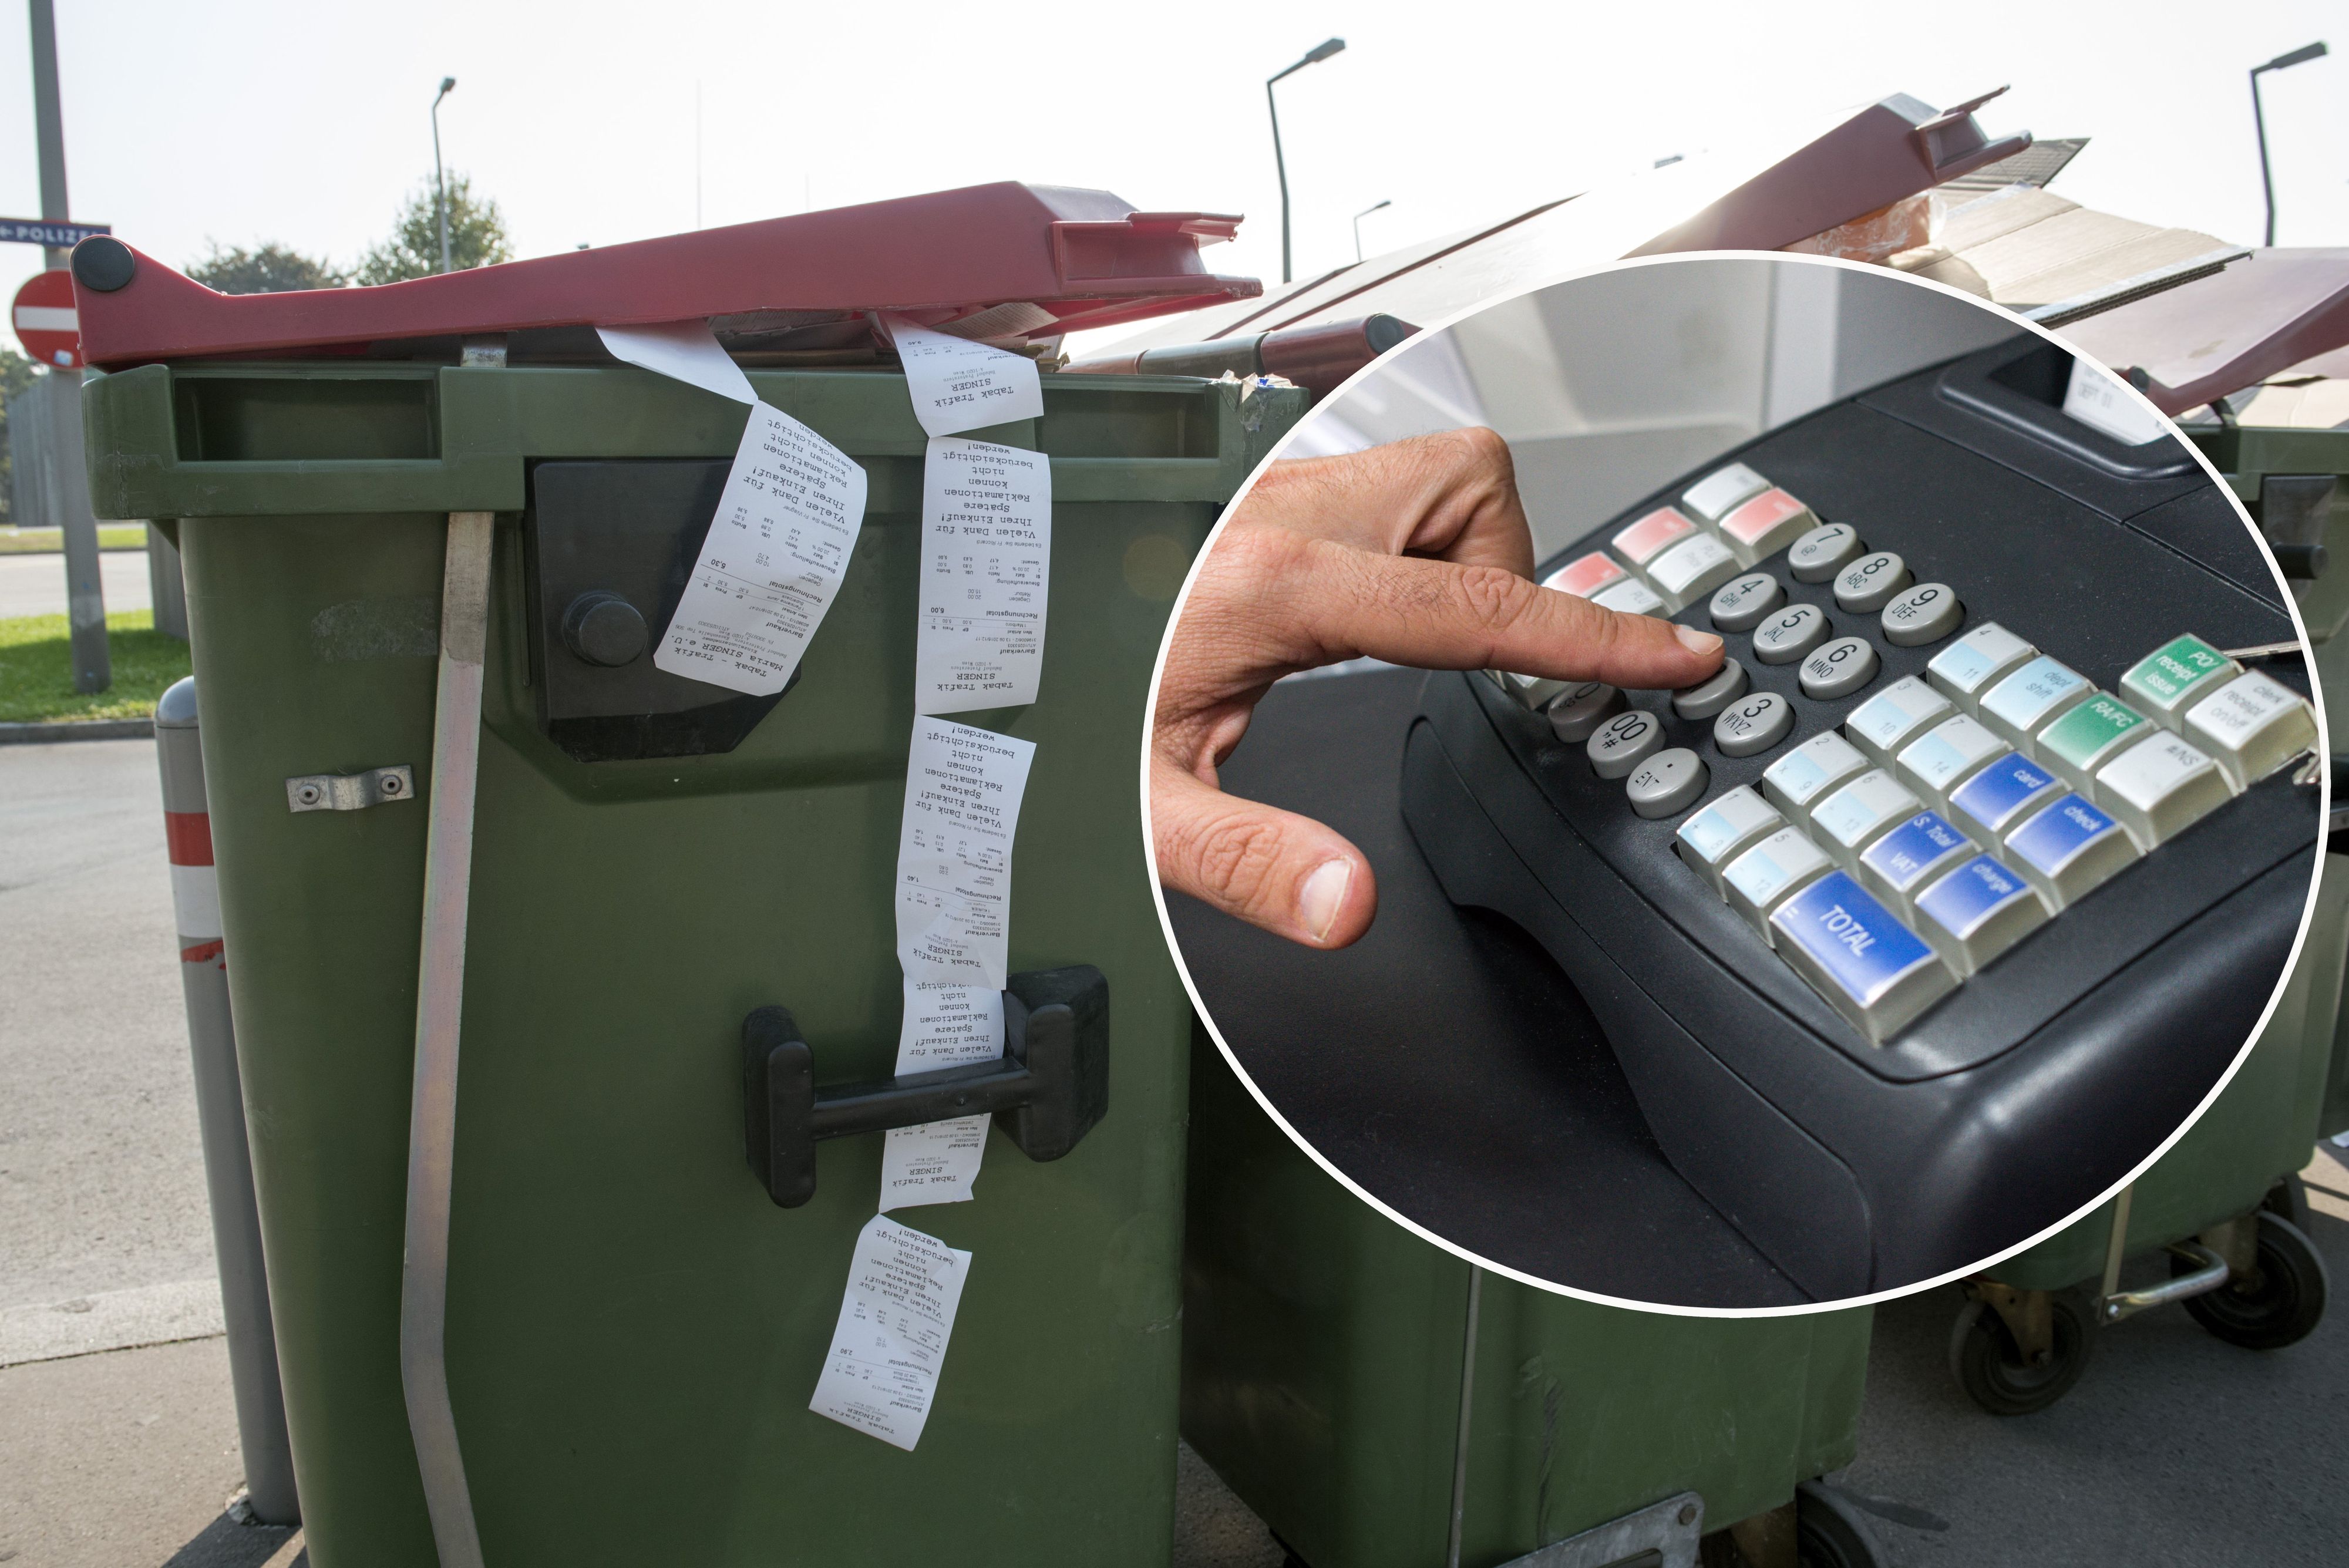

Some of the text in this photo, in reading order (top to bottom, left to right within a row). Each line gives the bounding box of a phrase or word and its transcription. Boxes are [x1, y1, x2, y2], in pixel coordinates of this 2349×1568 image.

[951, 378, 991, 391] SINGER
[934, 386, 1014, 407] Tabak Trafik
[767, 419, 852, 472] berücksichtigt
[968, 443, 1009, 454] werden!
[770, 433, 846, 477] können nicht
[943, 451, 1033, 469] berücksichtigt
[763, 443, 847, 487] Reklamationen
[972, 466, 1004, 476] nicht
[779, 463, 827, 489] Spätere
[968, 479, 1007, 489] können
[752, 466, 844, 510] Ihren Einkauf!
[944, 489, 1029, 502] Reklamationen
[743, 476, 844, 524] Vielen Dank für
[964, 502, 1009, 512] Spätere
[731, 520, 746, 529] Brutto
[941, 513, 1031, 526] Ihren Einkauf!
[935, 525, 1035, 539] Vielen Dank für
[1816, 528, 1844, 543] 7
[785, 541, 797, 549] Netto
[790, 551, 836, 574] Steueraufteilung:
[1863, 558, 1889, 574] 8
[711, 558, 822, 603] Rechnungstotal 5,30
[1741, 580, 1764, 595] 4
[1844, 573, 1868, 589] ABC
[1720, 592, 1740, 608] GHI
[1910, 588, 1939, 607] 9
[782, 607, 797, 615] Artikel
[986, 610, 1038, 619] Rechnungstotal
[1782, 610, 1810, 628] 5
[1892, 603, 1917, 620] DEF
[765, 621, 803, 638] Barverkauf
[1764, 626, 1785, 642] JKL
[671, 635, 783, 671] Maria SINGER e.U.
[674, 641, 714, 661] Trafik
[1829, 644, 1857, 662] 6
[734, 661, 766, 677] Tabak
[1808, 658, 1833, 678] MNO
[1963, 668, 1979, 679] 11
[2156, 655, 2200, 681] receipt
[1896, 682, 1911, 691] 3
[2044, 670, 2072, 689] dept
[2145, 672, 2177, 695] issue
[2025, 681, 2054, 699] shift
[2253, 685, 2286, 704] clerk
[1744, 698, 1772, 718] 3
[2222, 689, 2266, 716] receipt
[2089, 701, 2133, 727] RA/FC
[1611, 714, 1649, 741] 00
[1722, 712, 1752, 735] WXYZ
[1880, 721, 1897, 735] 10
[1949, 719, 1965, 728] 7
[952, 726, 994, 741] werden!
[1815, 737, 1830, 746] 2
[927, 732, 1015, 759] berücksichtigt
[951, 750, 982, 762] nicht
[947, 761, 983, 776] können
[1931, 761, 1950, 775] 14
[925, 768, 1002, 792] Reklamationen
[1634, 770, 1660, 790] ENT
[2013, 769, 2045, 790] card
[940, 783, 981, 799] Spätere
[921, 790, 1000, 816] Ihren Einkauf!
[915, 800, 1001, 828] Vielen Dank für
[2063, 806, 2102, 832] check
[1773, 833, 1789, 843] 5
[1924, 825, 1958, 847] Total
[1889, 853, 1919, 873] VAT
[1971, 862, 2014, 894] charge
[955, 886, 1001, 901] Rechnungstotal
[1819, 904, 1876, 957] TOTAL
[913, 948, 980, 967] Tabak Trafik
[927, 943, 962, 956] SINGER
[940, 992, 965, 1001] nicht
[920, 1013, 987, 1023] Reklamationen
[935, 1024, 972, 1033] Spätere
[916, 1037, 958, 1046] Einkauf!
[909, 1166, 942, 1175] SINGER
[893, 1175, 956, 1187] Tabak Trafik
[898, 1229, 937, 1247] werden!
[876, 1229, 953, 1267] berücksichtigt
[898, 1249, 926, 1264] nicht
[893, 1257, 927, 1274] können
[871, 1259, 943, 1291] Reklamationen
[885, 1273, 926, 1290] Spätere
[859, 1281, 941, 1318] Vielen Dank für
[864, 1274, 941, 1308] Ihren Einkauf!
[888, 1358, 932, 1375] Rechnungstotal
[847, 1407, 881, 1422] SINGER
[889, 1400, 922, 1412] Barverkauf
[829, 1407, 894, 1434] Tabak Trafik
